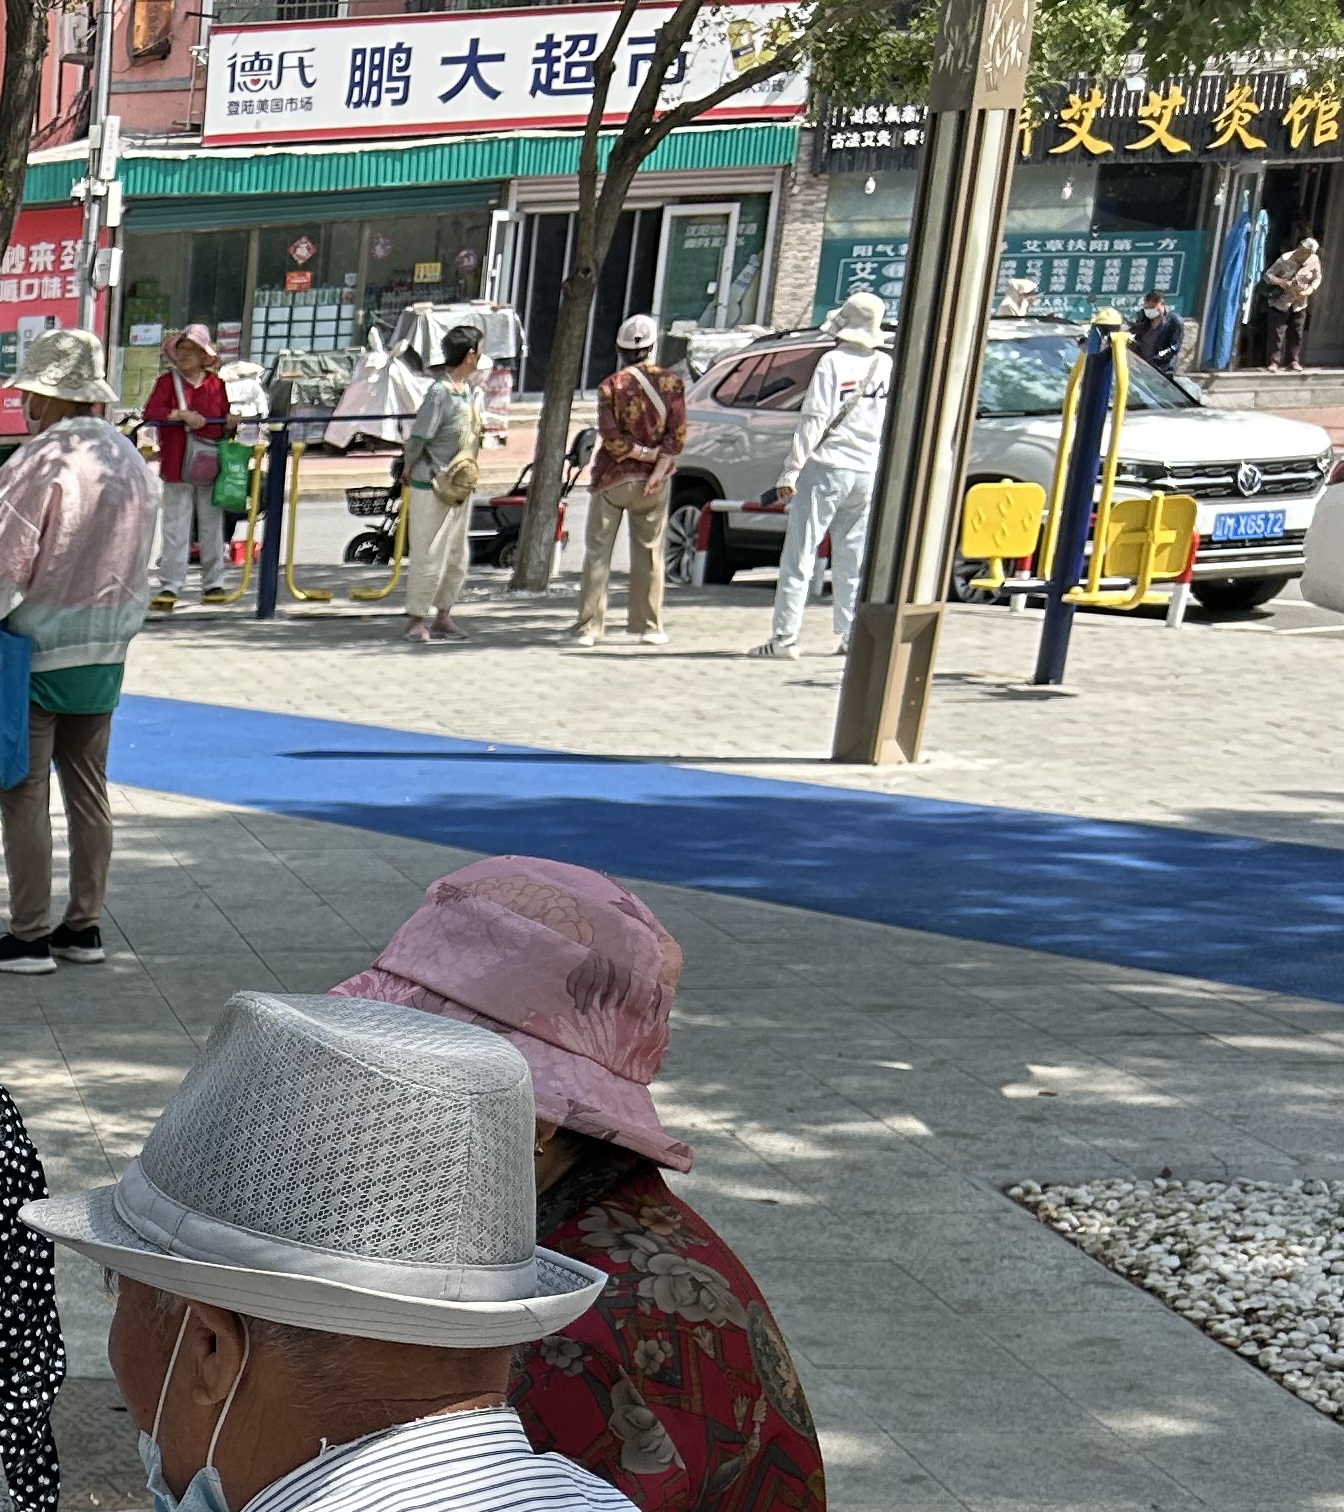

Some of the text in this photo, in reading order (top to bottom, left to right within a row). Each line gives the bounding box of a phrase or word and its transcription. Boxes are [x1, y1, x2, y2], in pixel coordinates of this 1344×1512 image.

[227, 46, 317, 93] 德氏
[226, 96, 313, 116] 登陆美国市场
